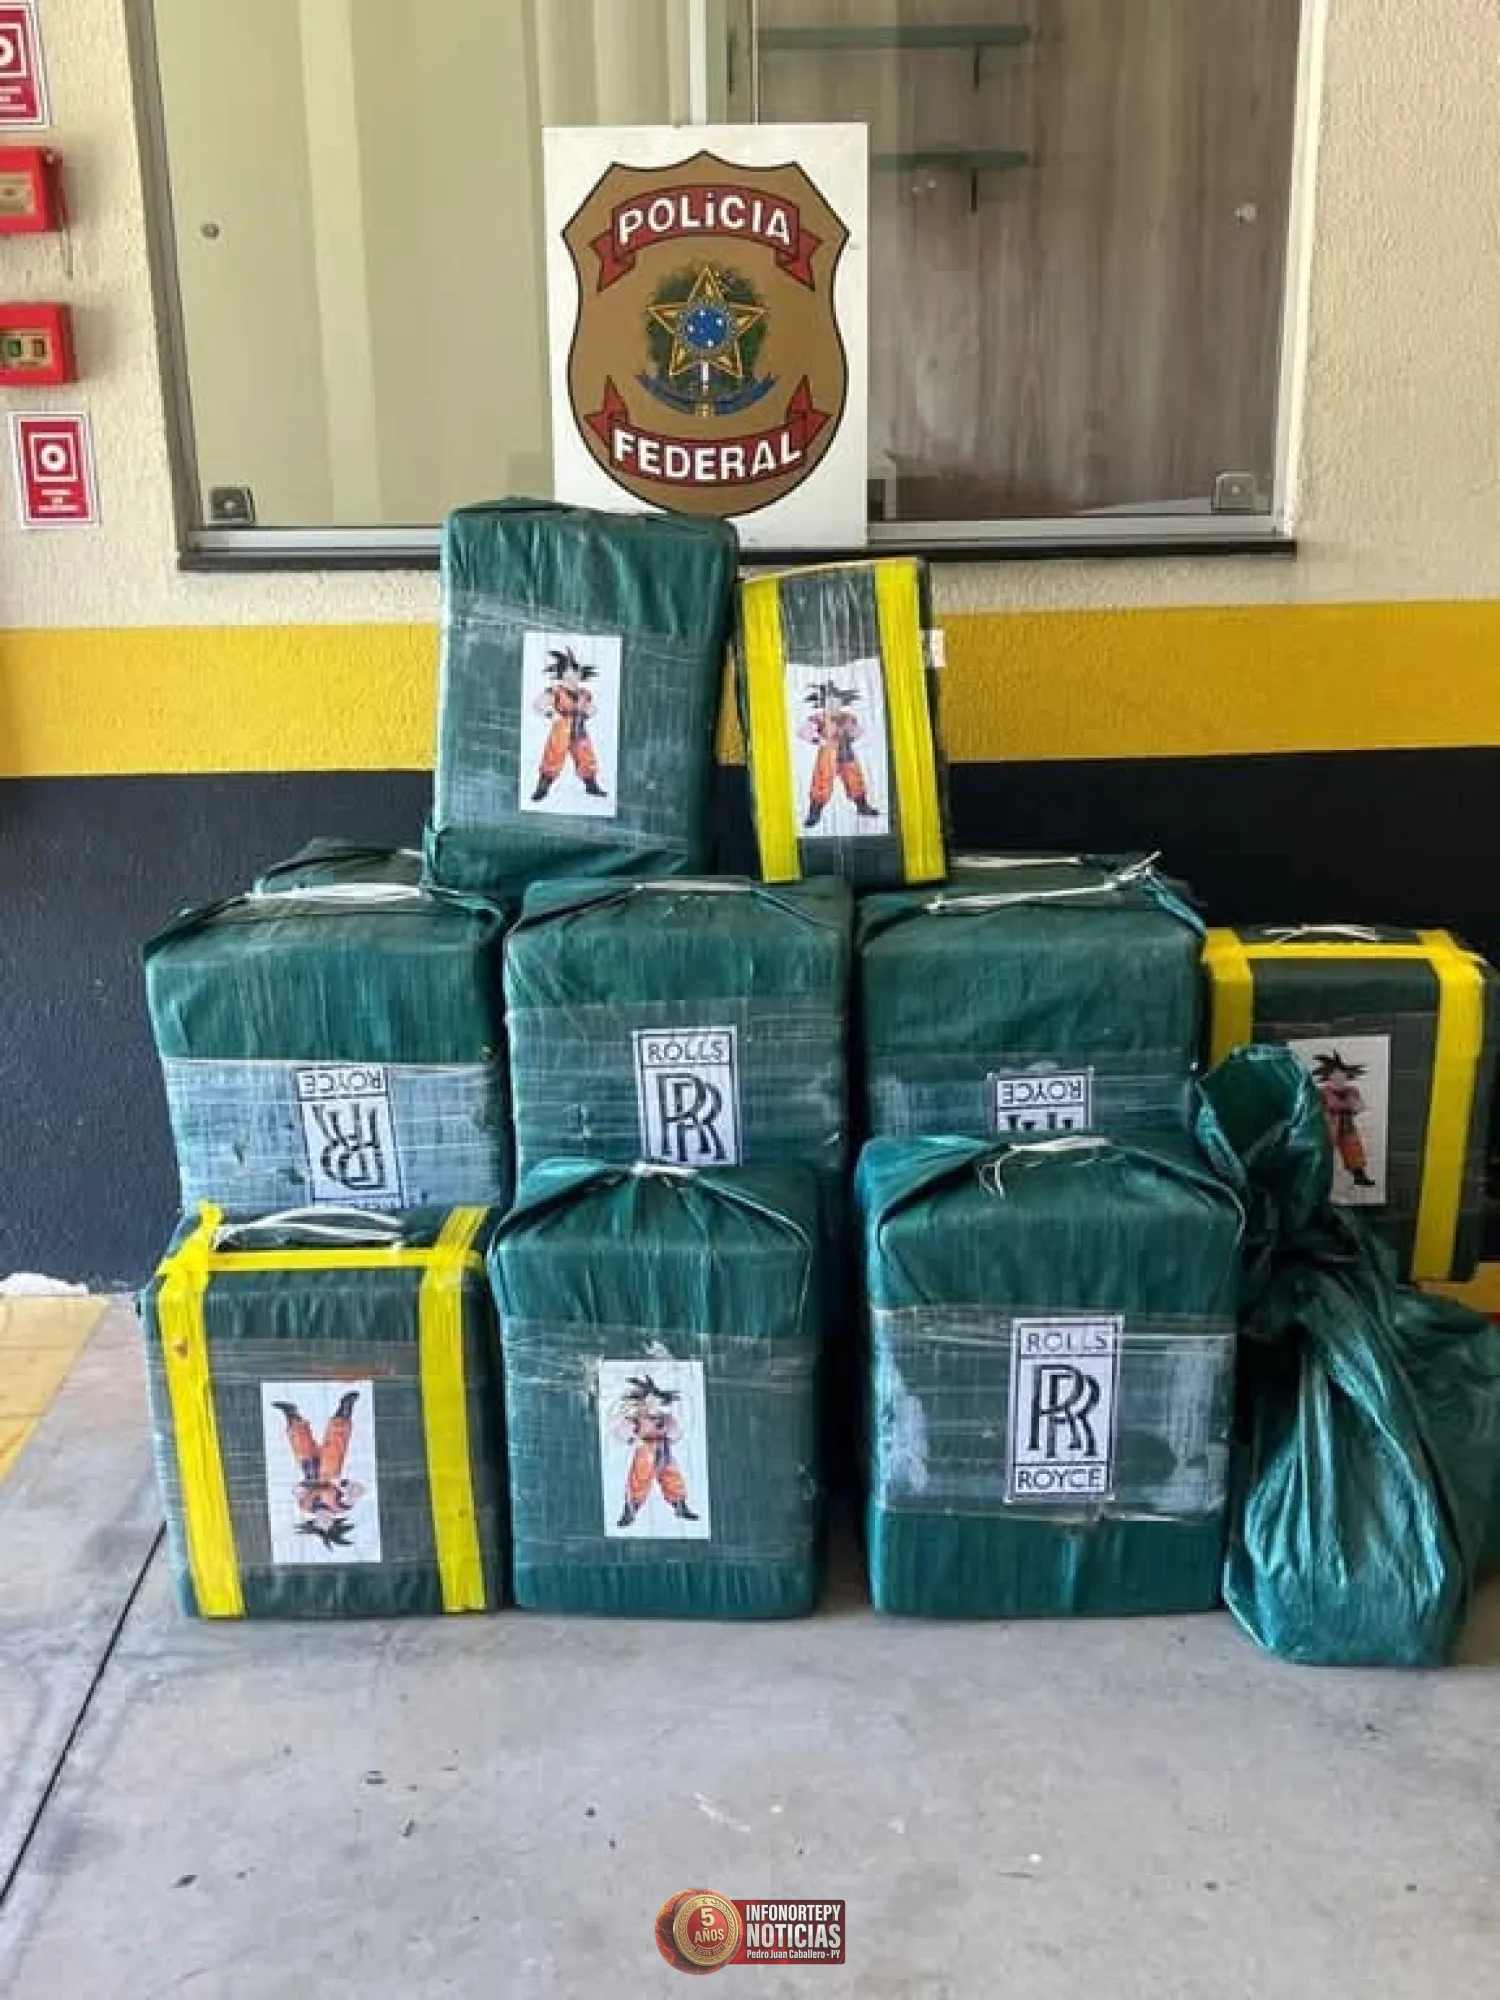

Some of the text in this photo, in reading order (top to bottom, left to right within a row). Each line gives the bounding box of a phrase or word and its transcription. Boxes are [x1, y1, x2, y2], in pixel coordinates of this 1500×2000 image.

[612, 428, 803, 482] FEDERAL
[648, 1039, 725, 1061] ROLLS
[301, 1070, 381, 1094] ROYCE
[1002, 1081, 1081, 1104] ROYCE
[1026, 1331, 1107, 1352] ROLLS
[1017, 1468, 1104, 1490] ROYCE
